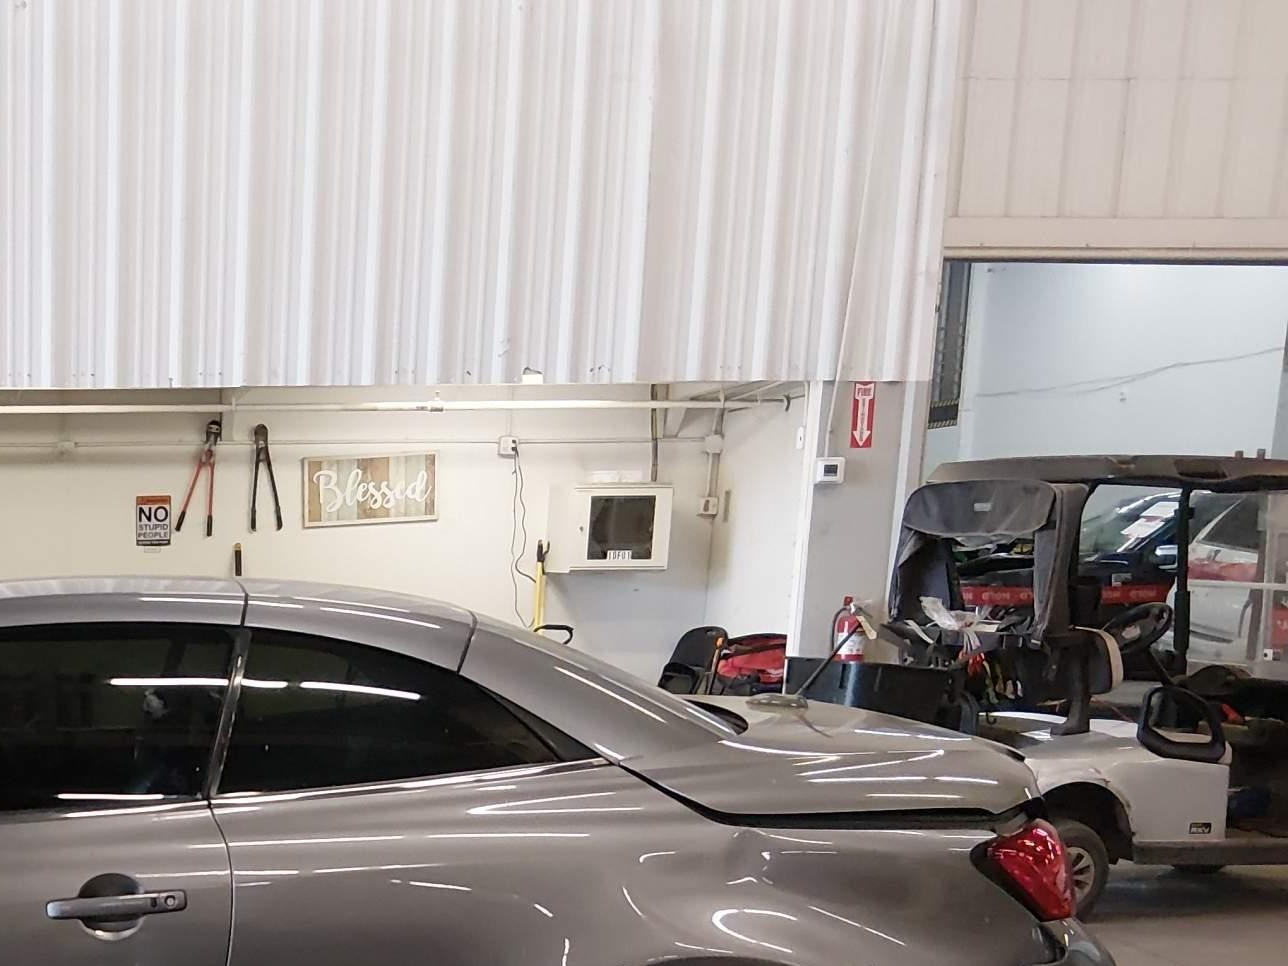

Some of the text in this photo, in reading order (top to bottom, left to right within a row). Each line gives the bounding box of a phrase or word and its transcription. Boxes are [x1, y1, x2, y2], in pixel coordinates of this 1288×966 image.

[312, 468, 433, 513] Blessed
[138, 505, 169, 523] NO
[138, 523, 169, 531] STUPID
[137, 531, 168, 539] PEOPLE
